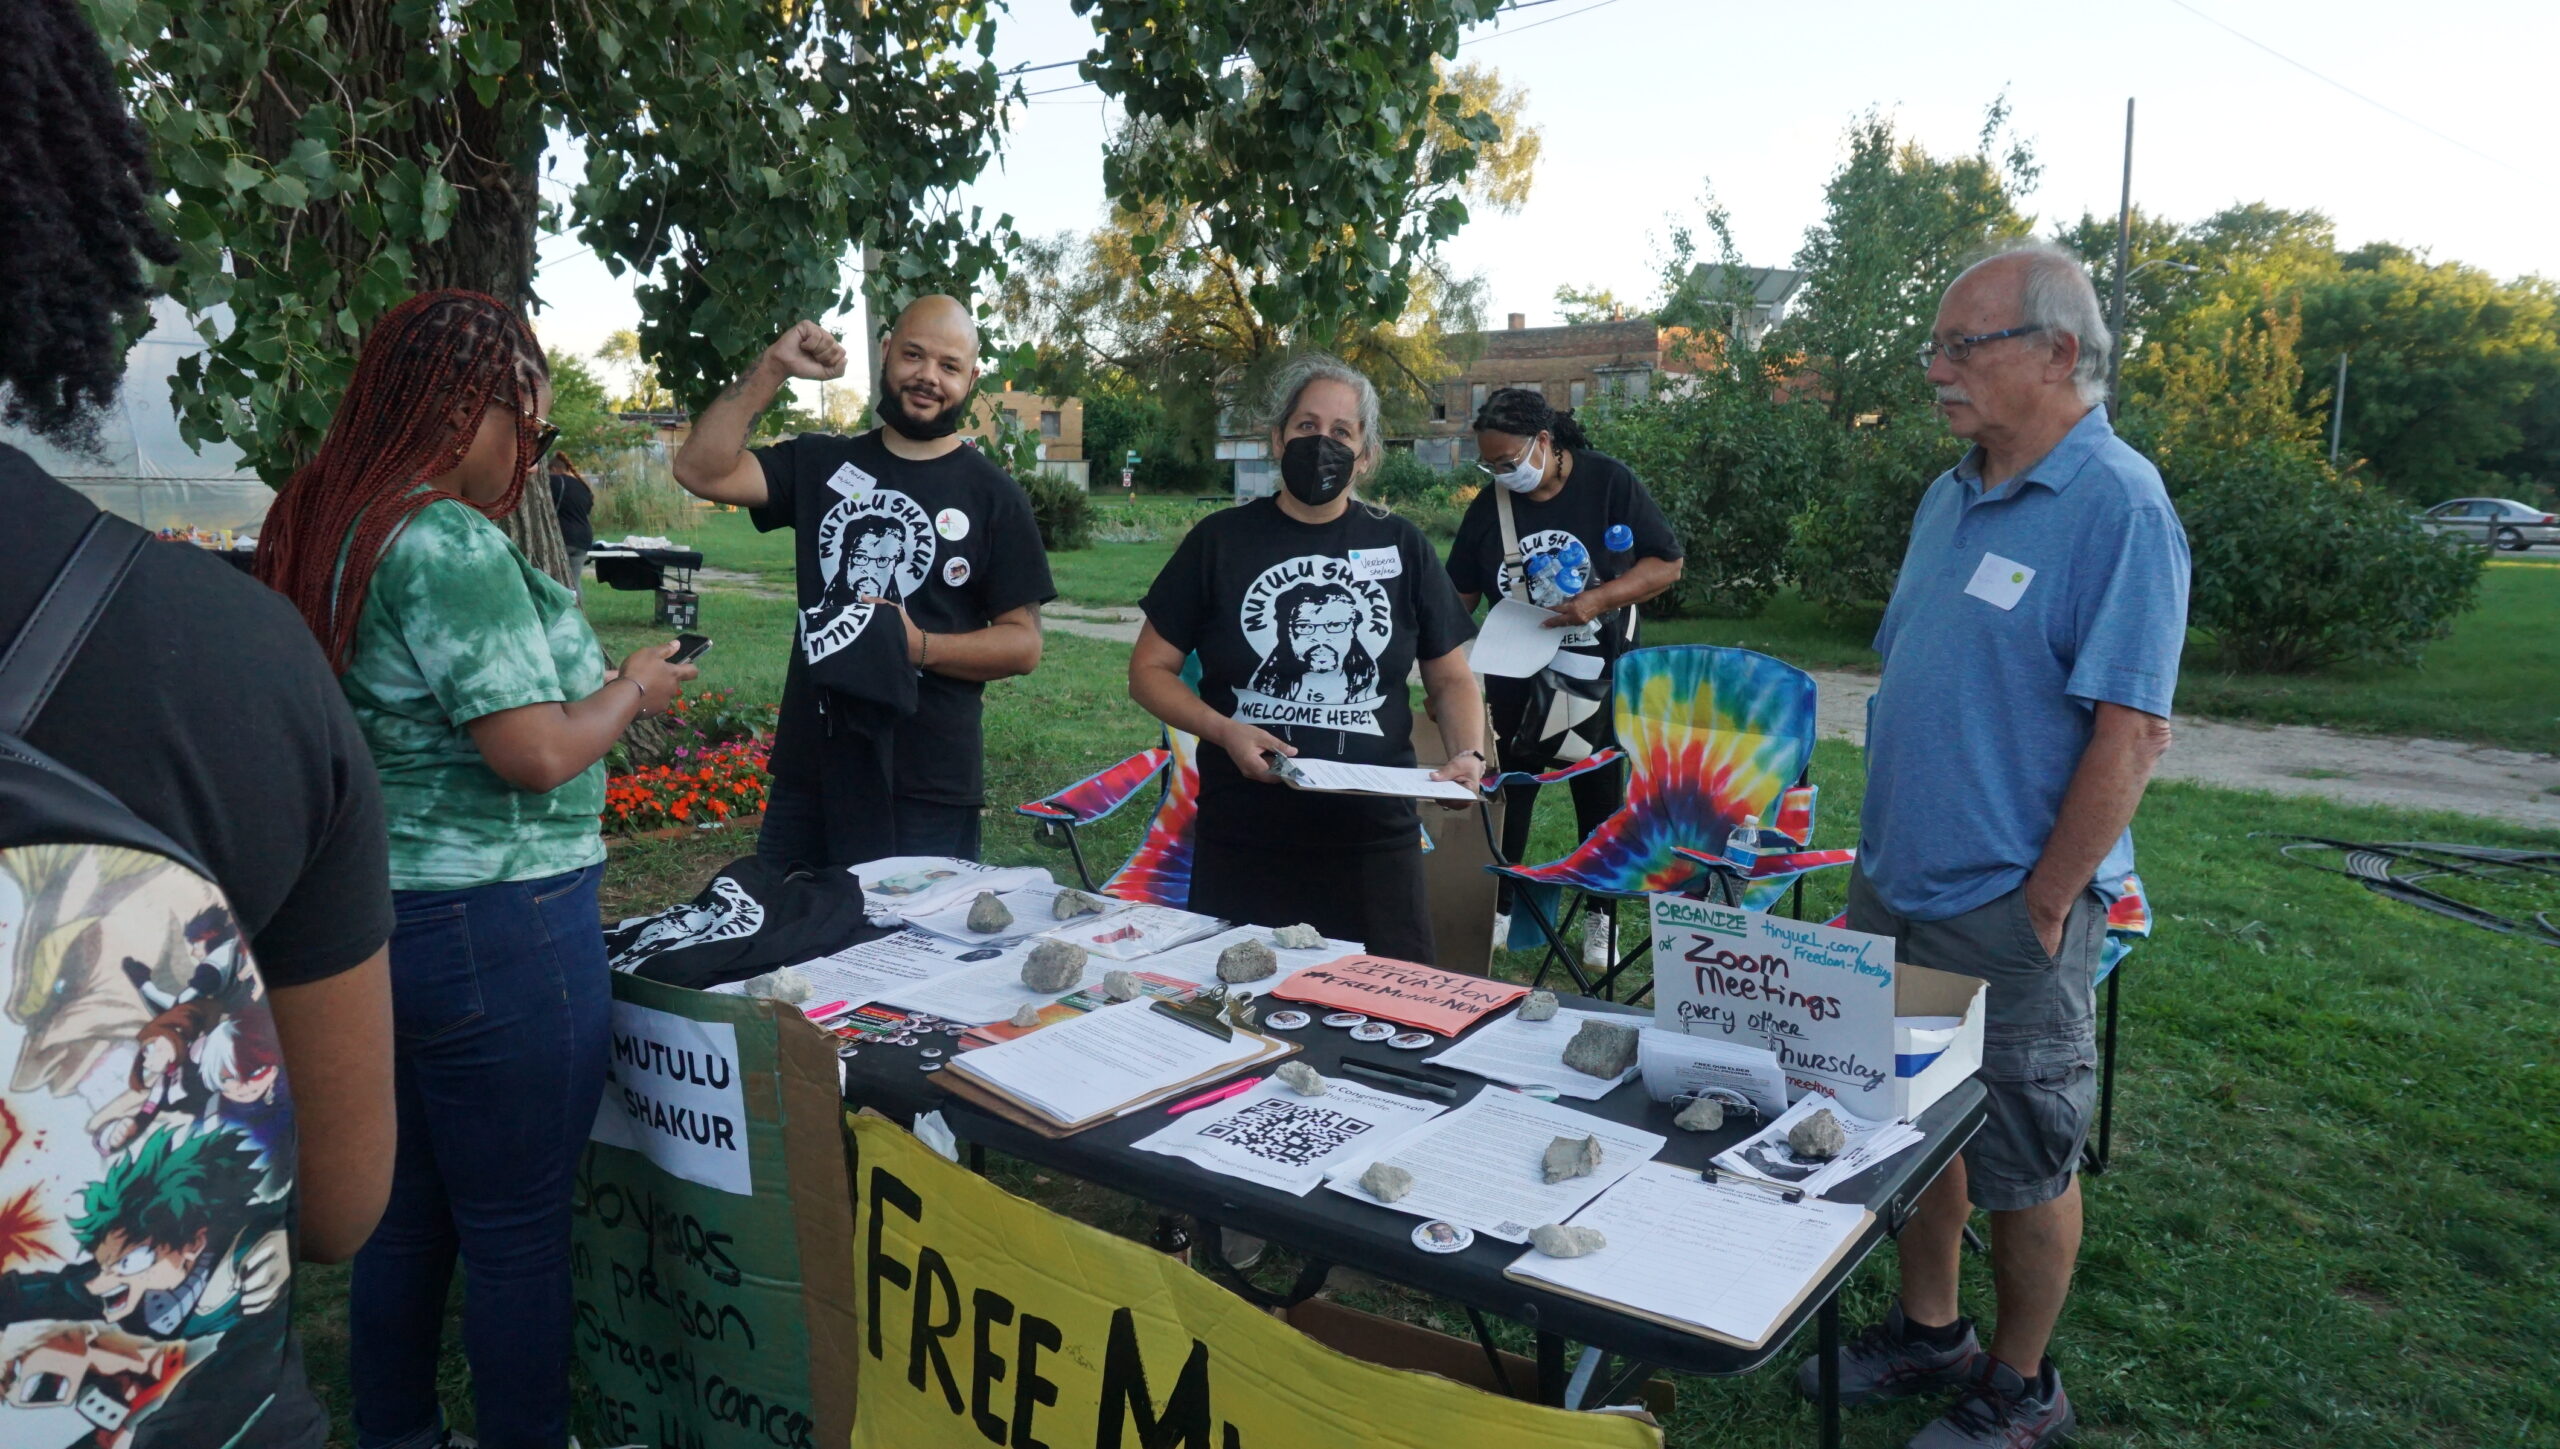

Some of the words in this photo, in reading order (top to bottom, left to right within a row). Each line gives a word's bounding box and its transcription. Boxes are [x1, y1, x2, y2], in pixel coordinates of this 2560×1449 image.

[819, 493, 887, 560] MUTULU
[890, 497, 934, 581] SHAKUR
[1243, 560, 1314, 633] MUTULU
[1322, 562, 1389, 638] SHAKUR
[1241, 702, 1322, 724] WELCOME
[1327, 710, 1373, 726] HERE!
[1306, 689, 1325, 703] is
[1655, 901, 1748, 931] ORGANIZE
[1350, 960, 1493, 988] URGENT
[1658, 935, 1677, 952] at
[1684, 933, 1790, 979] Zoom
[1341, 966, 1501, 1004] SITUATION
[1694, 965, 1841, 1021] Meetings
[1677, 1000, 1736, 1034] every
[613, 1031, 730, 1089] MUTULU
[624, 1087, 737, 1151] SHAKUR
[1338, 1086, 1426, 1113] Congressperson
[867, 1166, 1064, 1449] FREE
